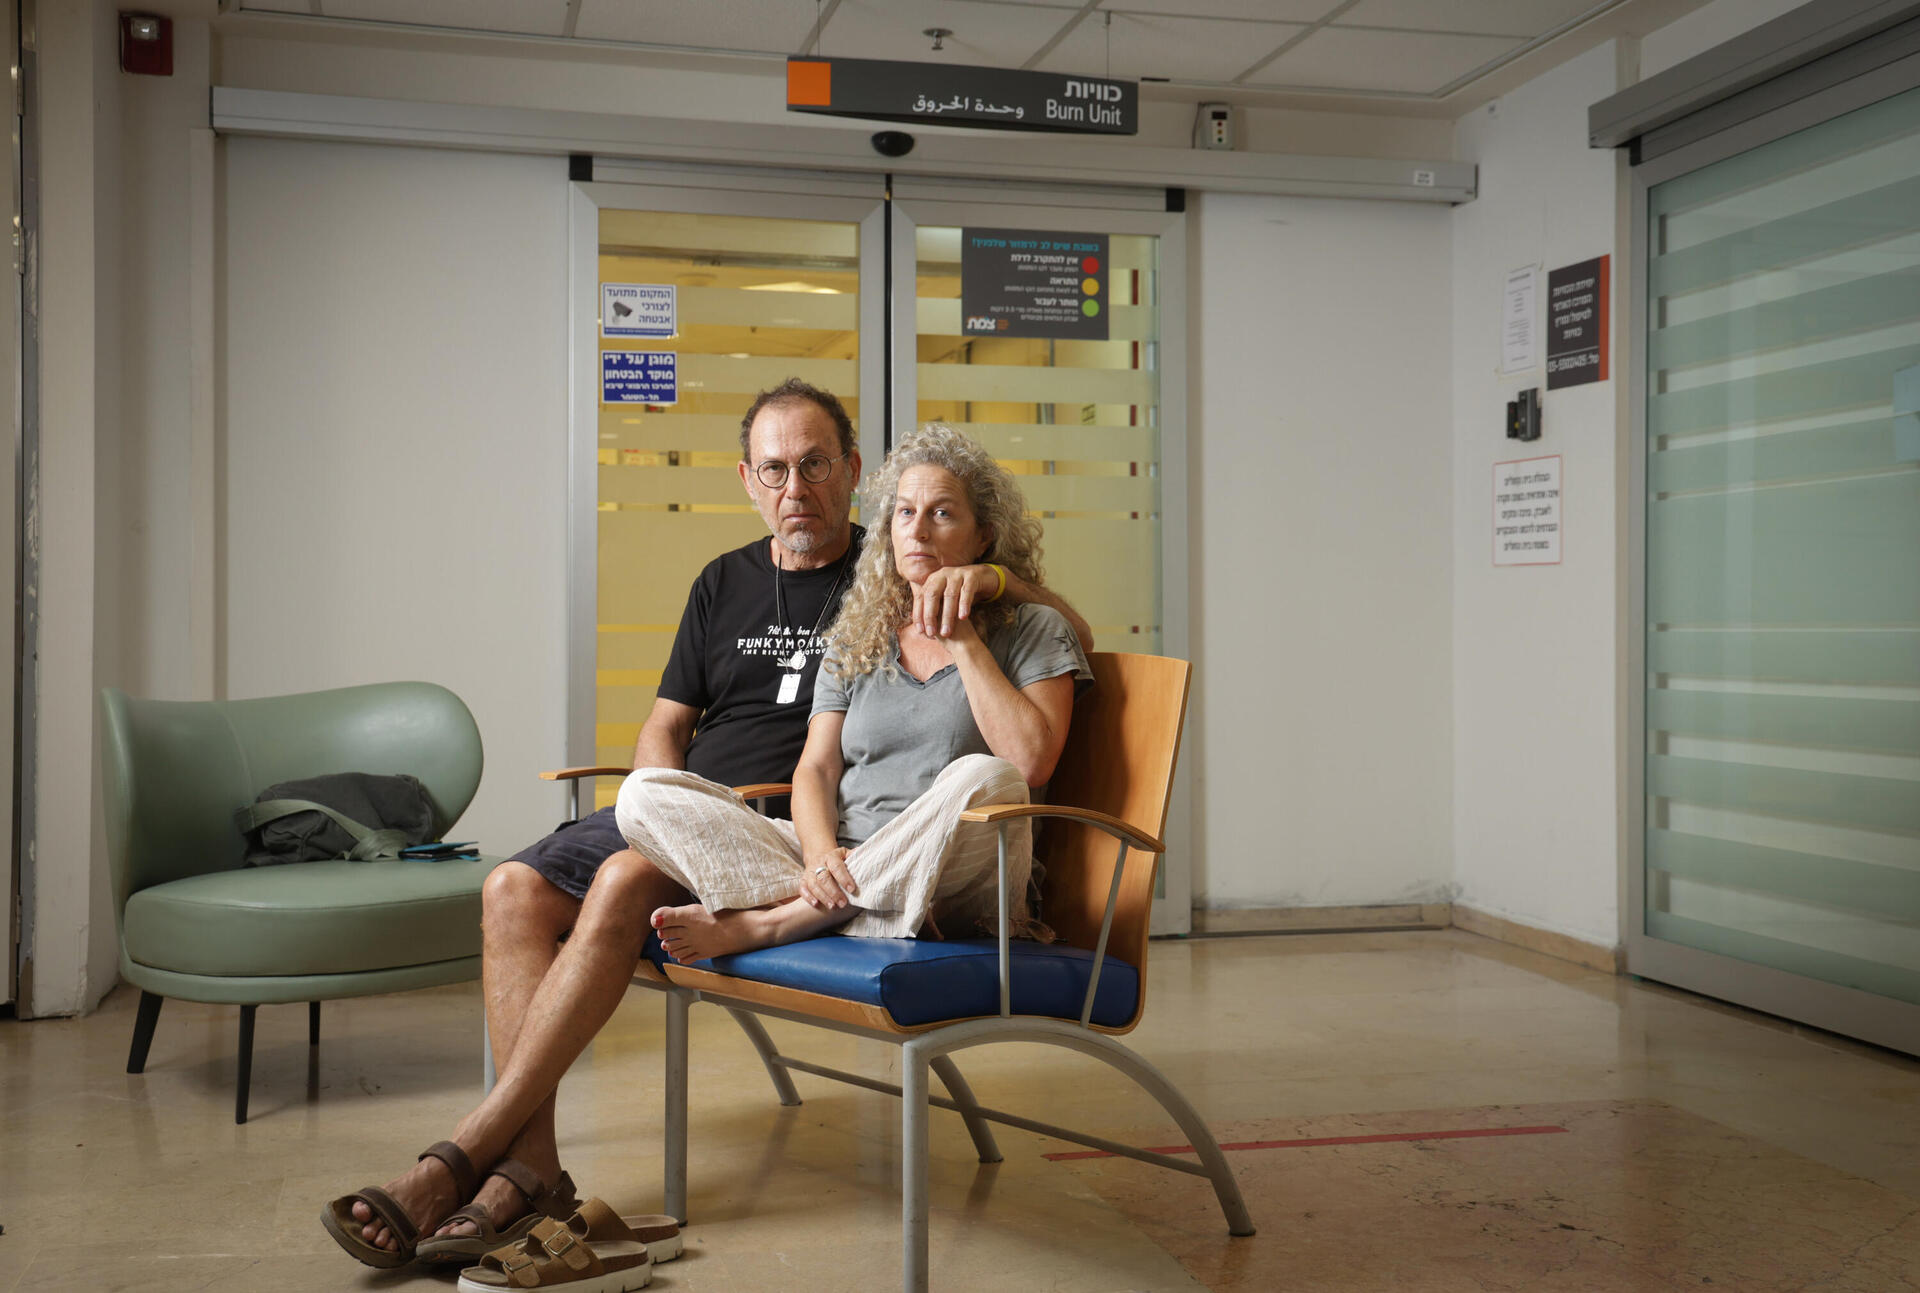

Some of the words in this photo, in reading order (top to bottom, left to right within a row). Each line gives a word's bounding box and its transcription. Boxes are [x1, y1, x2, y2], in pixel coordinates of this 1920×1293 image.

[1064, 80, 1122, 101] כוויות
[912, 94, 969, 113] الحروق
[975, 98, 1025, 119] وحدة
[1046, 99, 1083, 121] Burn
[1089, 103, 1122, 126] Unit
[1040, 240, 1051, 250] לב
[1010, 253, 1031, 262] לדלת
[1033, 254, 1065, 264] להתקרב
[1066, 256, 1079, 265] אין
[1050, 277, 1079, 285] התראה
[607, 288, 637, 298] מתועד
[640, 289, 671, 299] המקום
[641, 302, 670, 311] לצורכי
[1033, 297, 1057, 306] לעבור
[1058, 298, 1078, 307] מותר
[638, 315, 670, 324] אבטחה
[604, 353, 621, 365] ידי
[625, 353, 644, 365] על
[648, 354, 674, 366] מוגן
[605, 369, 644, 380] הבטחון
[647, 369, 674, 380] מוקד
[737, 636, 826, 649] FUNKYMONK
